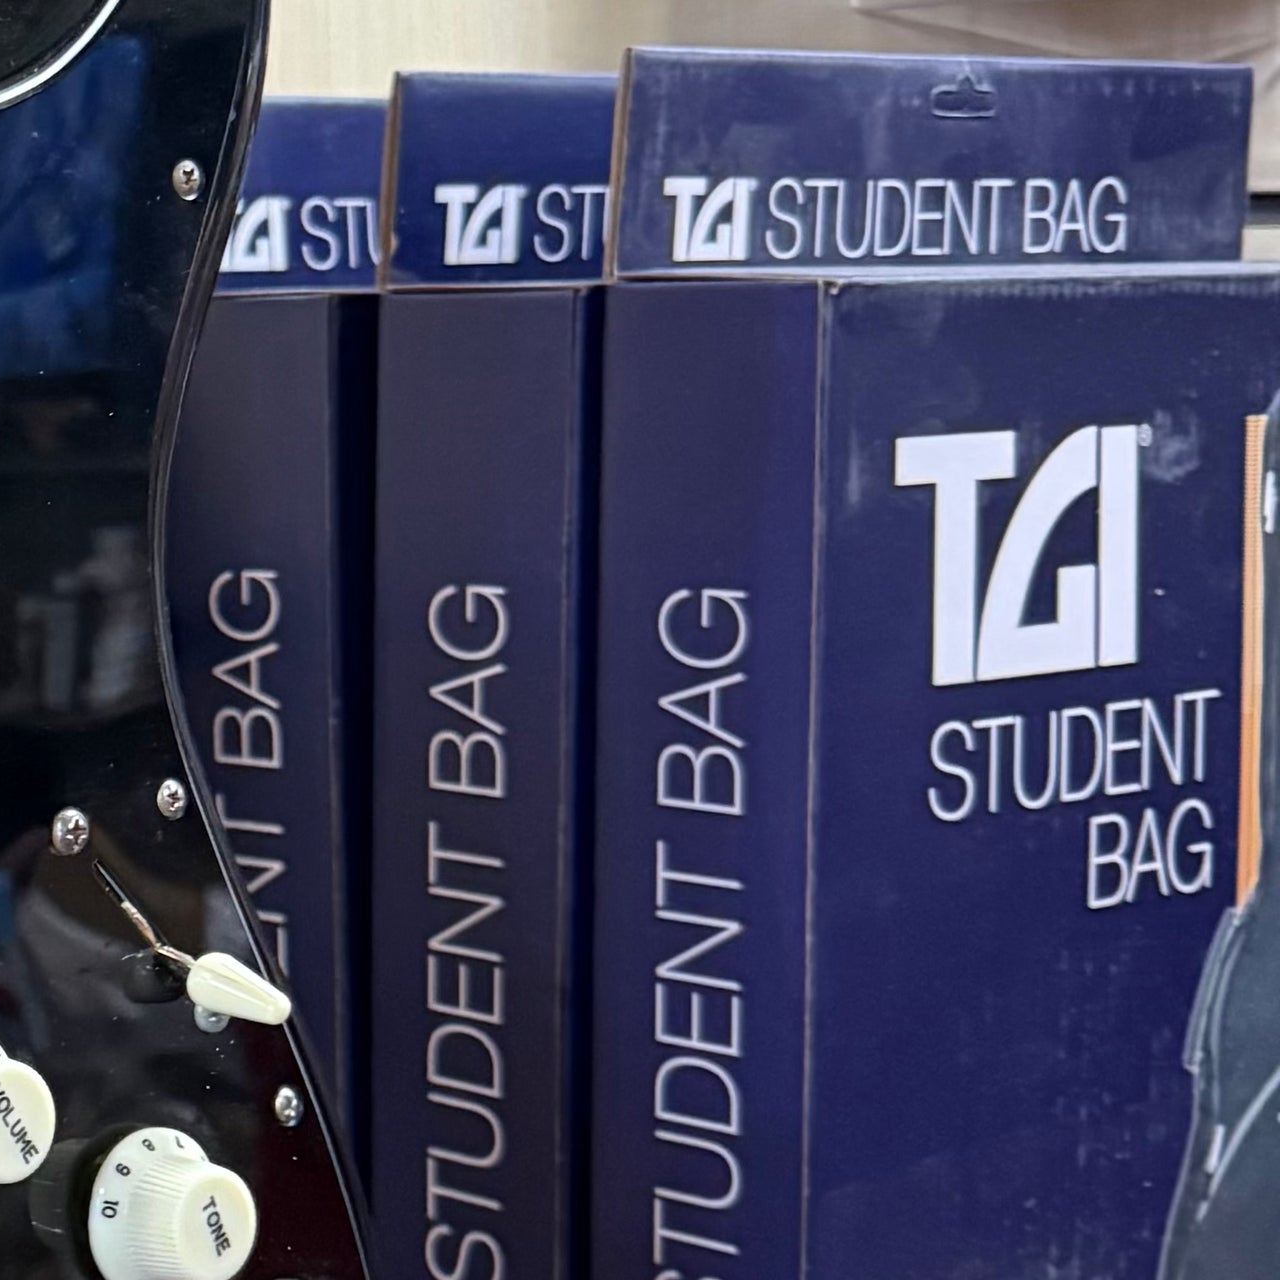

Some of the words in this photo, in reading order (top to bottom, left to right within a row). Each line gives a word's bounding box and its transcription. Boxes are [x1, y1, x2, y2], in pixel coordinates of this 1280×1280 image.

[764, 177, 1017, 261] STUDENT
[1022, 176, 1128, 256] BAG
[208, 568, 283, 769] BAG
[427, 583, 507, 798] BAG
[657, 587, 747, 816] BAG
[927, 688, 1222, 822] STUDENT
[1085, 799, 1214, 910] BAG
[115, 1162, 132, 1177] 9
[141, 1138, 156, 1152] 8
[101, 1199, 120, 1219] 10
[201, 1195, 232, 1257] TONE
